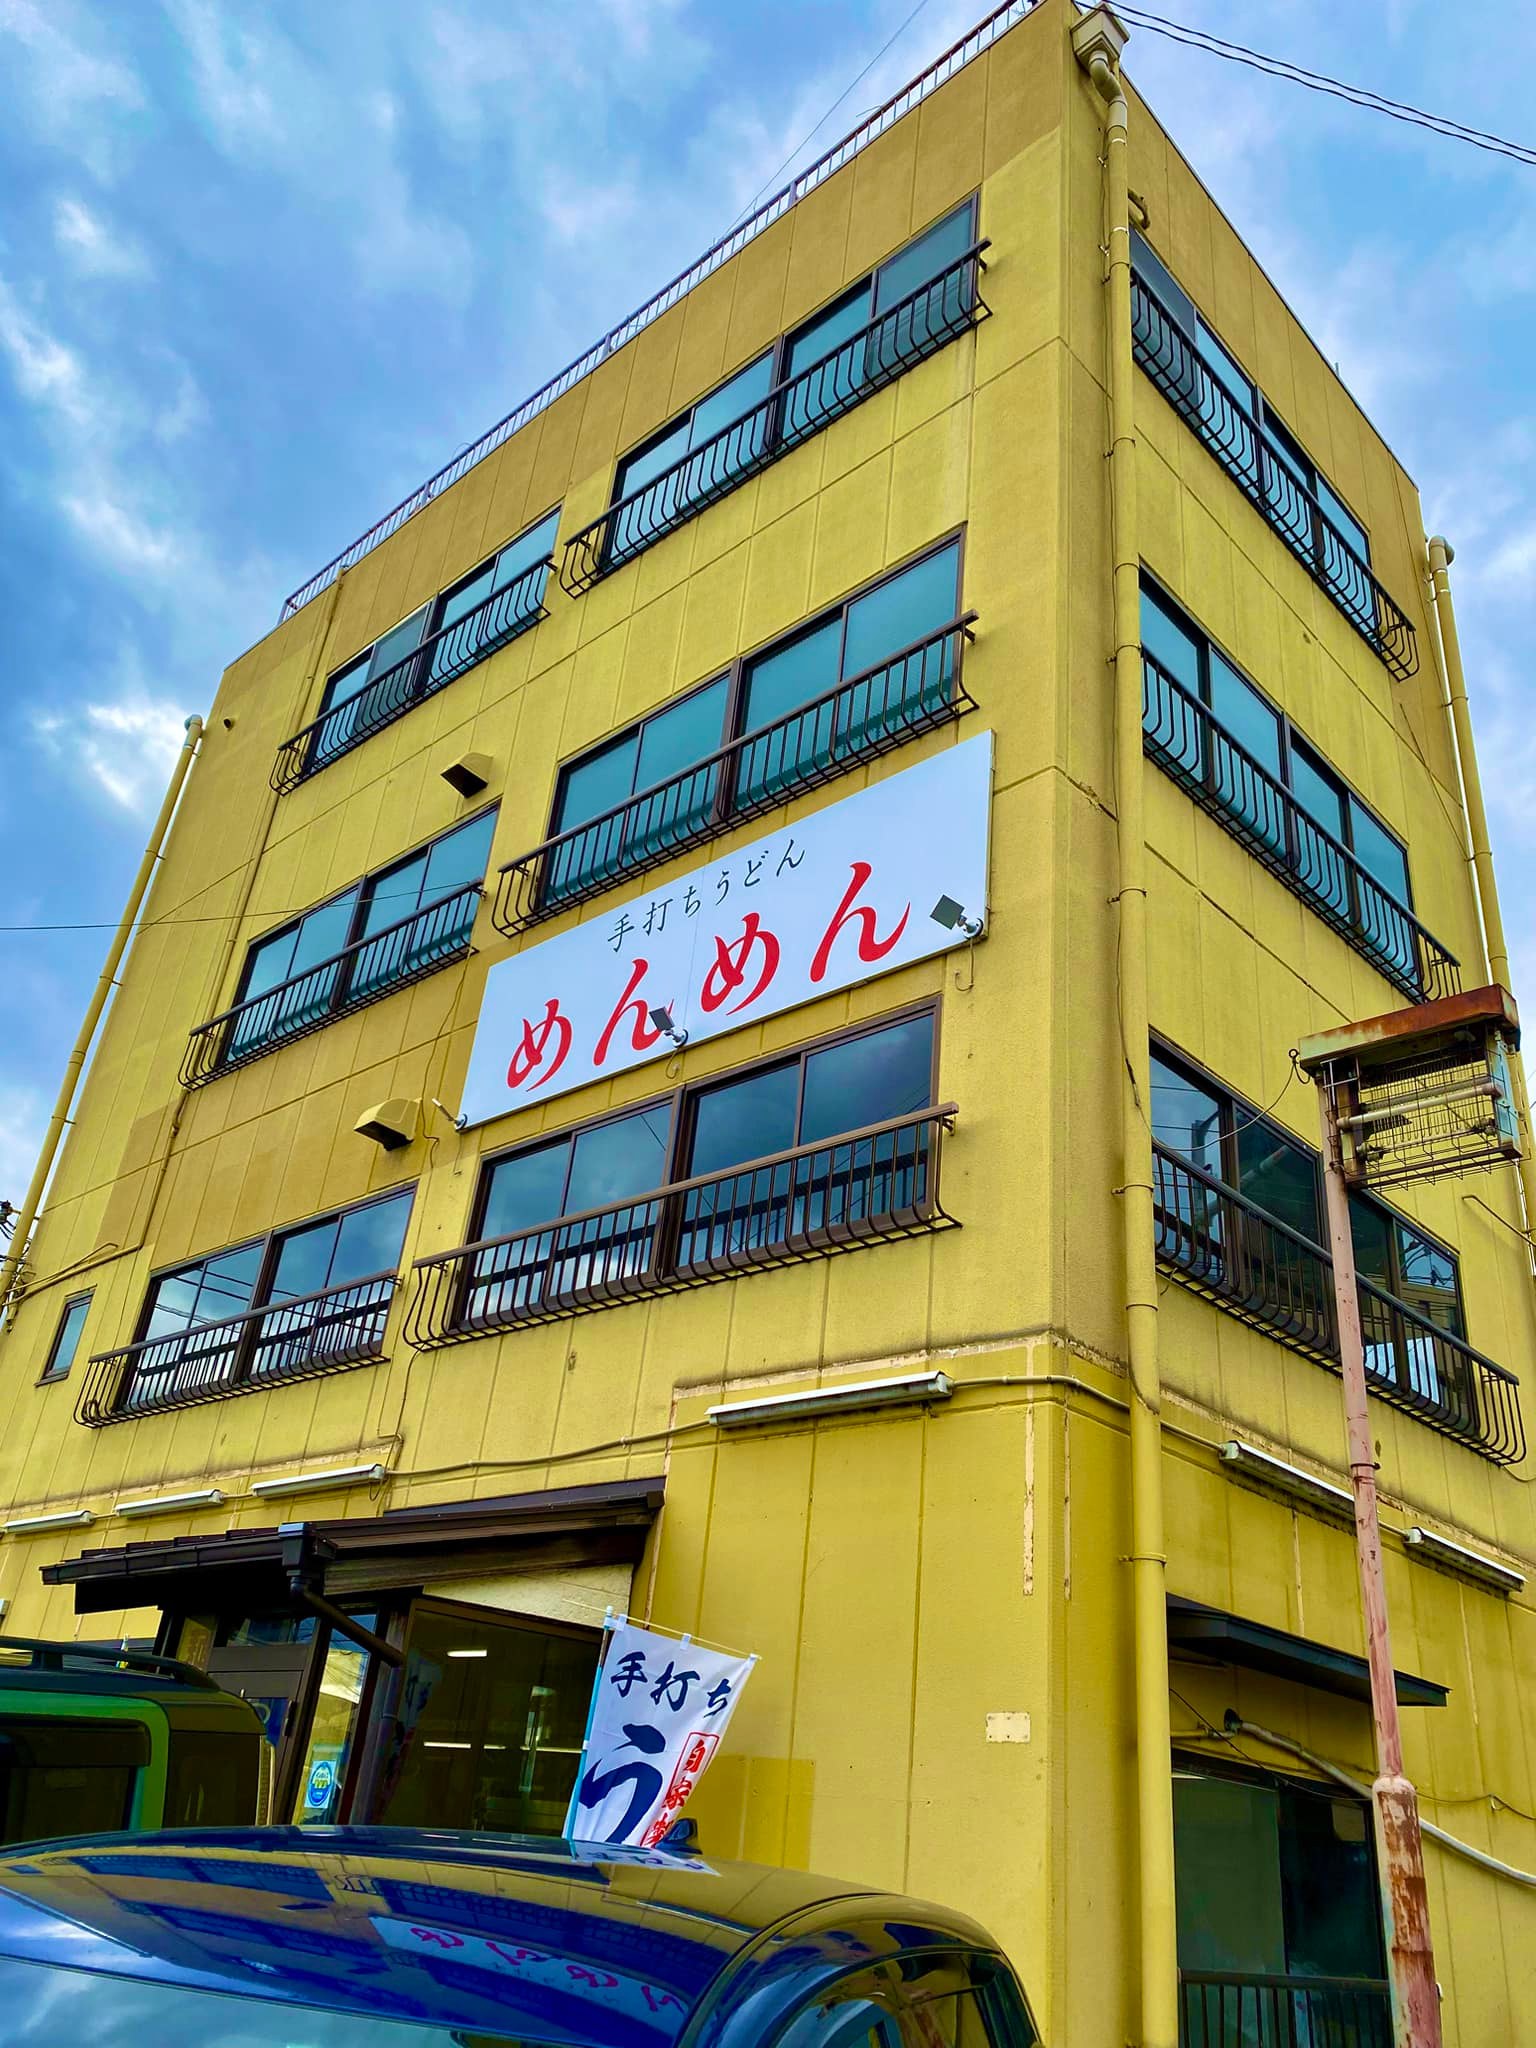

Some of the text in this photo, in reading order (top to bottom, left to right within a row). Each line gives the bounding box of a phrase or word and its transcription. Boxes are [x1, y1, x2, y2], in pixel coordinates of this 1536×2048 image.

[607, 838, 806, 953] 手打ちうどん
[506, 861, 911, 1091] めんめん
[610, 1651, 732, 1718] 手打ち
